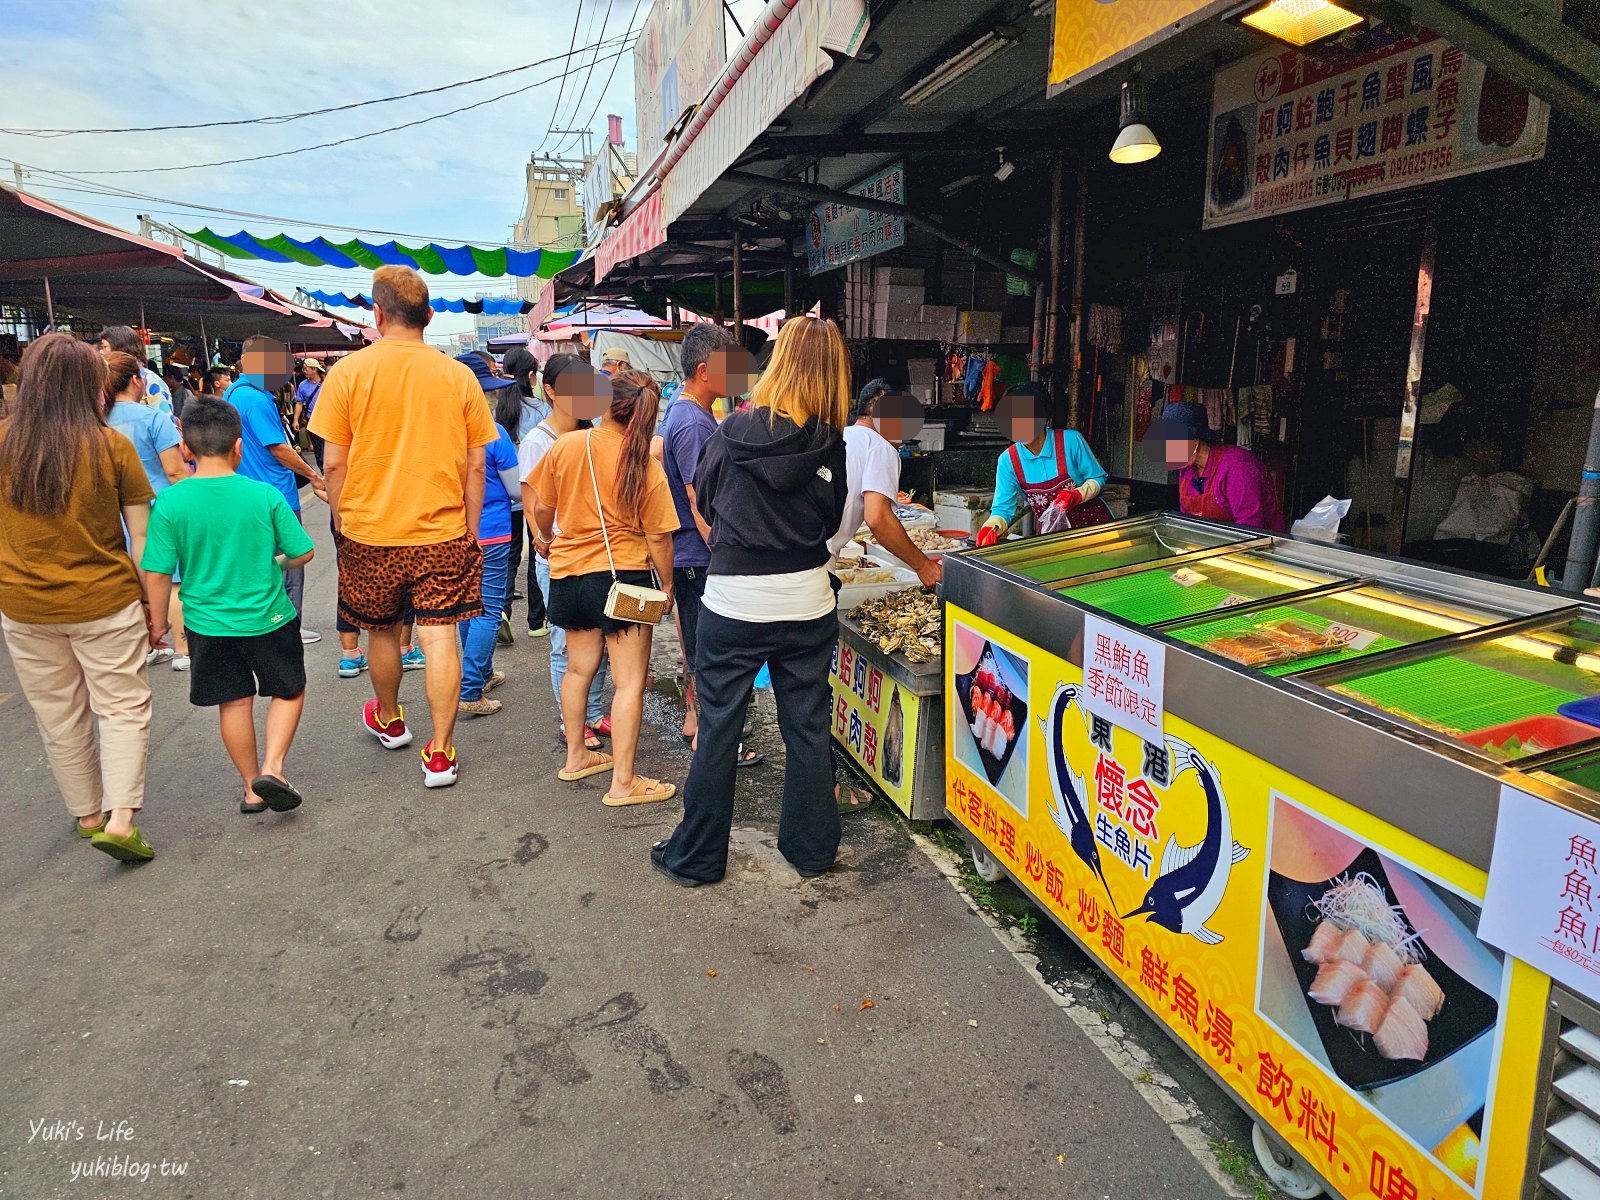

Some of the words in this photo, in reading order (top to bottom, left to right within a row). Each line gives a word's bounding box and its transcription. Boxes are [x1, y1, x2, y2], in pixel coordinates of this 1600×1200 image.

[1094, 632, 1150, 688] 黑鮪魚
[1087, 667, 1158, 728] 季節限定
[1095, 752, 1160, 840] 懷念
[1096, 812, 1152, 878] 生魚片
[1560, 869, 1600, 913] 魚
